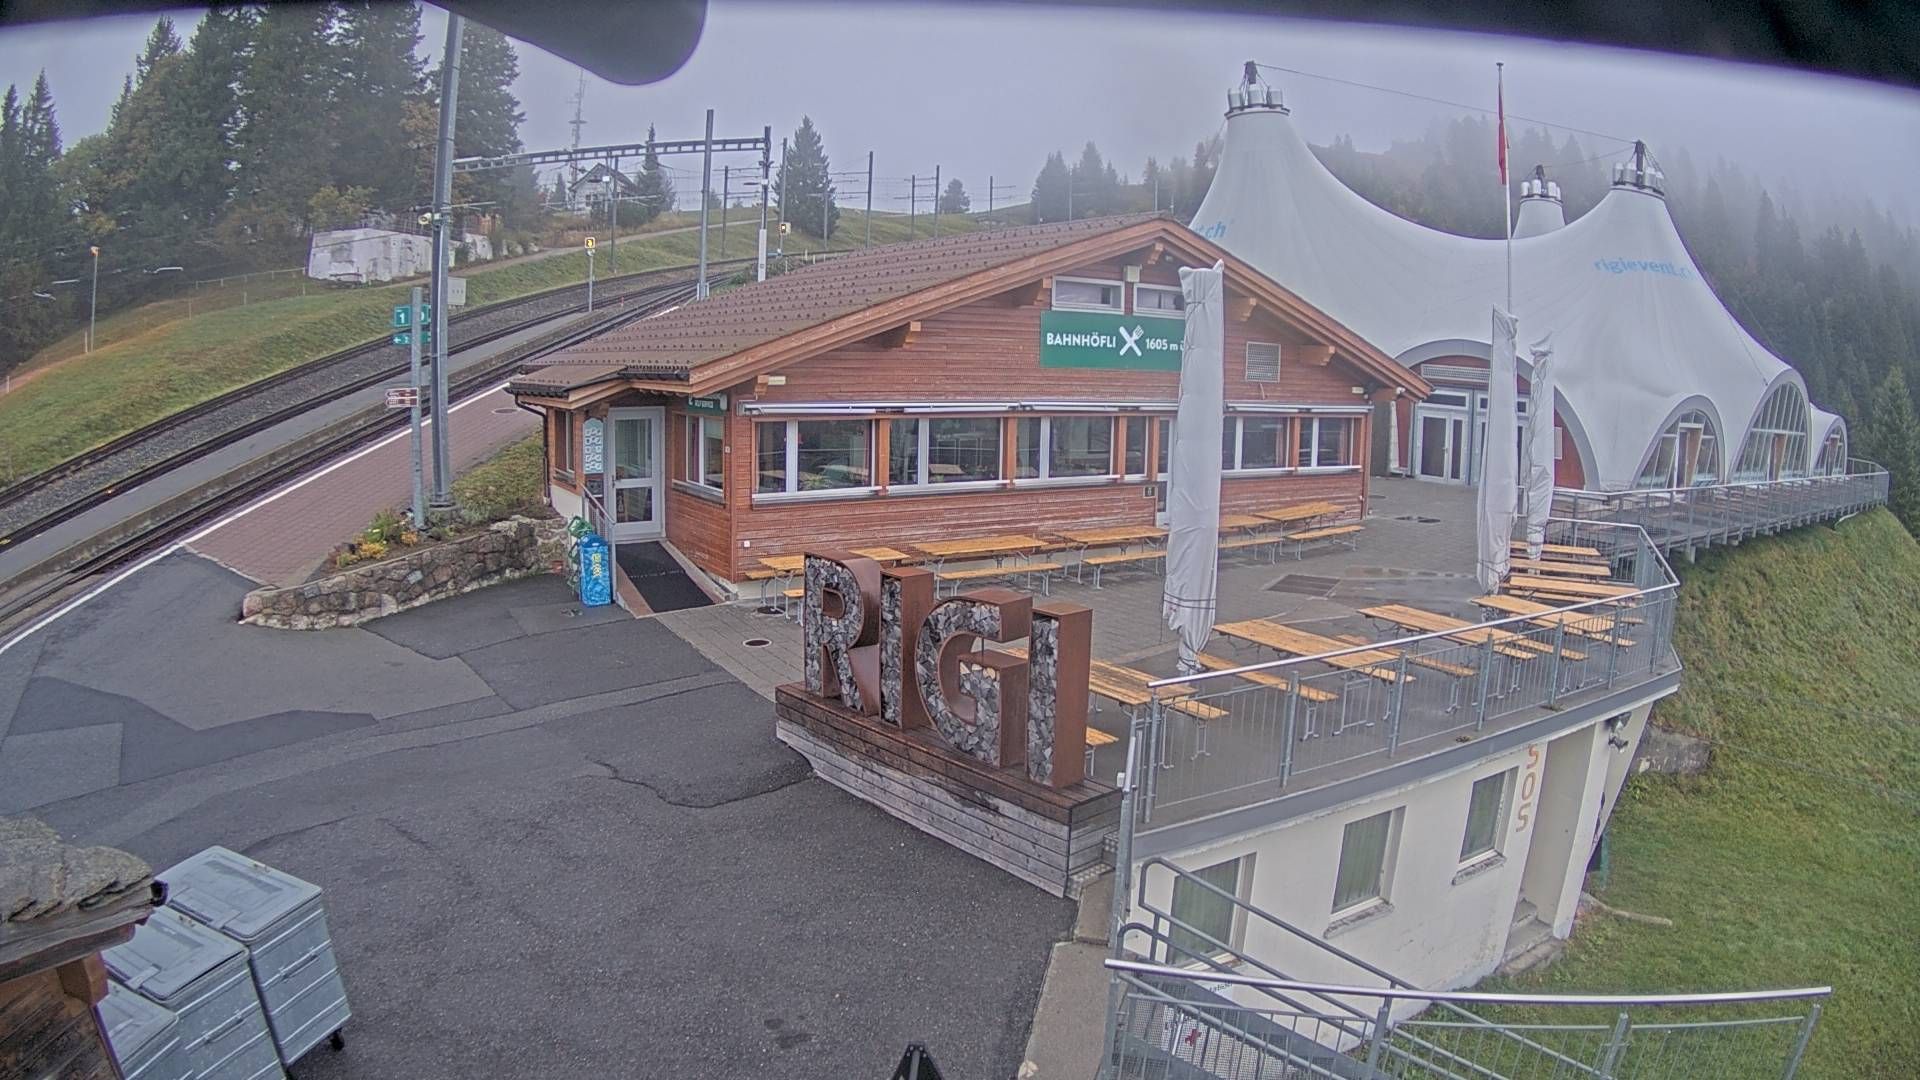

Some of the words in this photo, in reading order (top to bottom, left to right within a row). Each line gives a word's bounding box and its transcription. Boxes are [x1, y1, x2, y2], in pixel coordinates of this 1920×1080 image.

[399, 312, 405, 324] 1
[1046, 331, 1116, 349] BAHNHÖFLI
[1145, 337, 1168, 351] 1605
[1169, 343, 1179, 351] m
[803, 550, 1093, 789] RIGI
[1515, 743, 1540, 833] SOS
